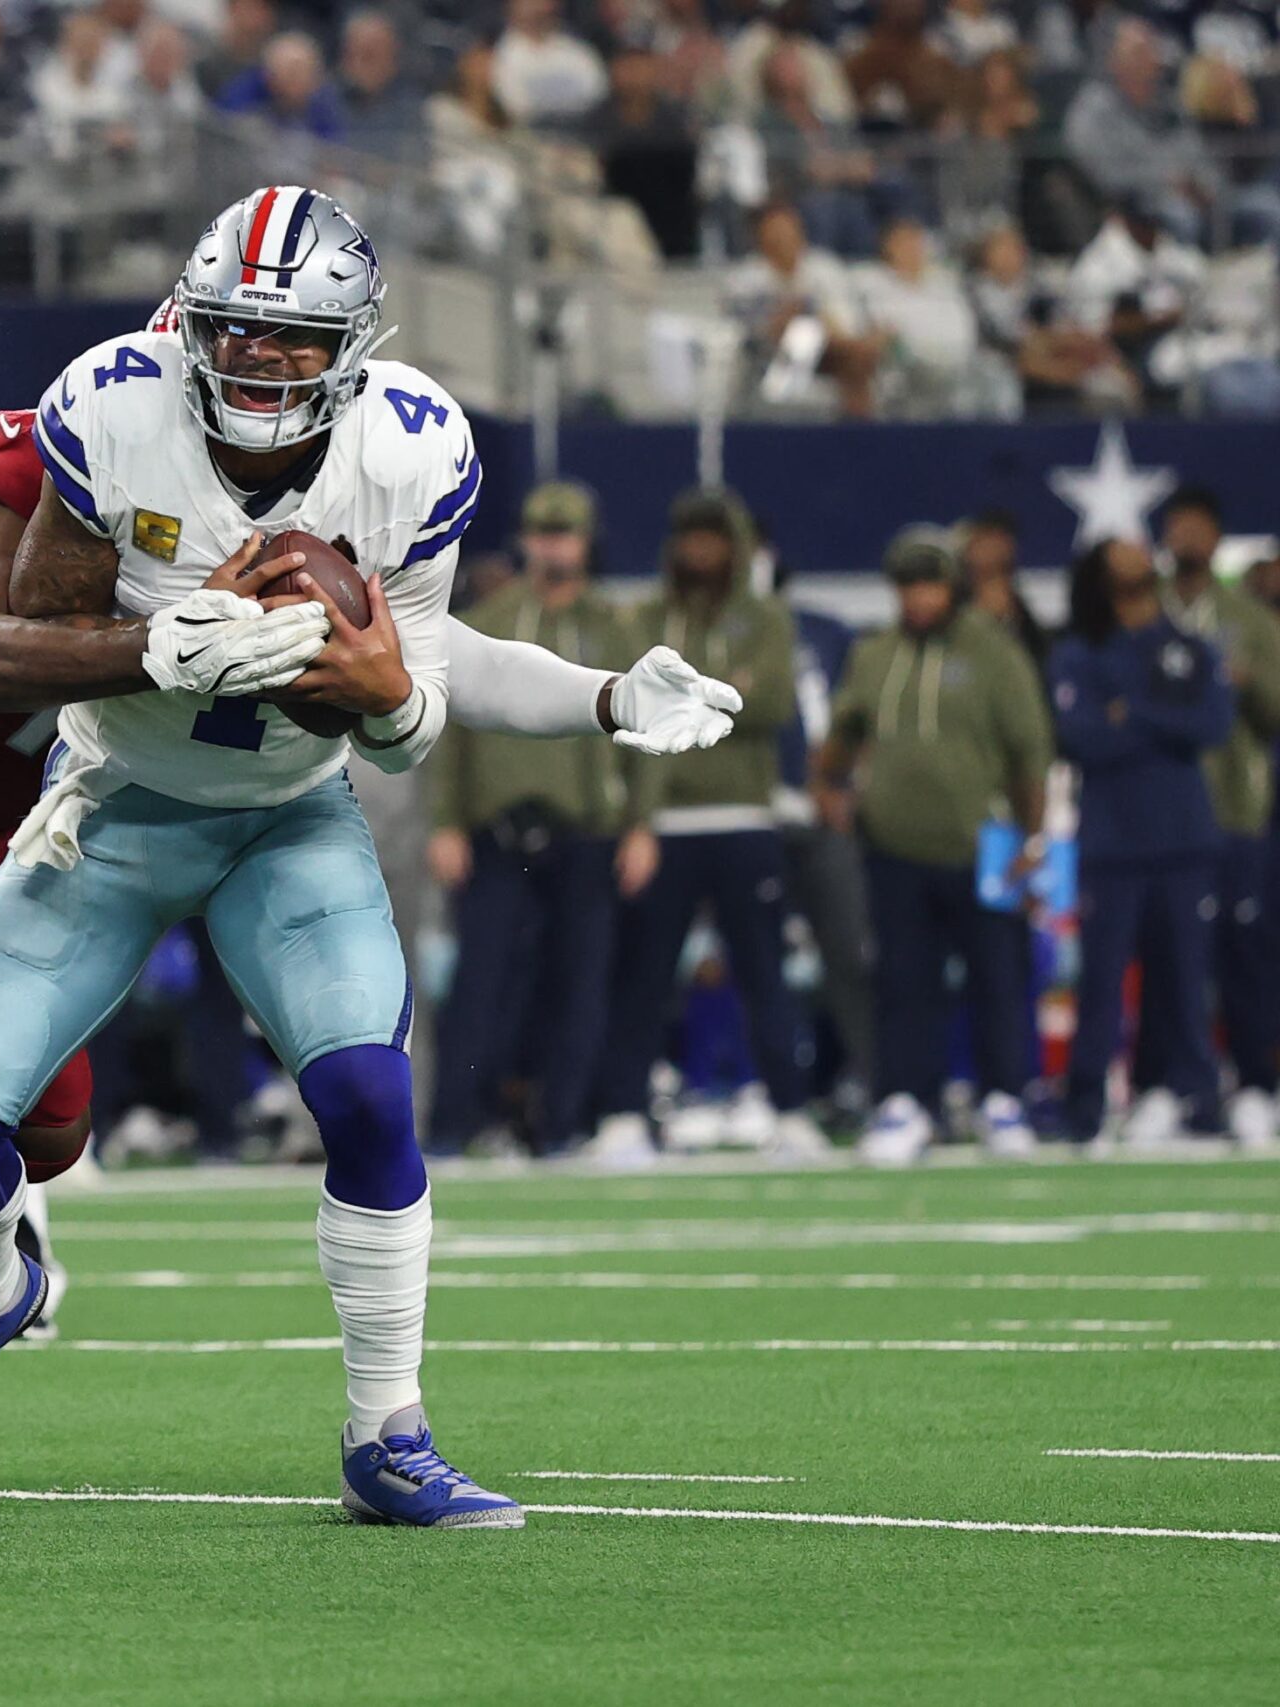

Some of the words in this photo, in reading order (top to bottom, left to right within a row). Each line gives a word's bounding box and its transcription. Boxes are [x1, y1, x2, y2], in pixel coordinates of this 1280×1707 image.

[241, 290, 288, 303] COWBOYS
[93, 346, 162, 391] 4
[383, 387, 449, 434] 4
[135, 511, 179, 552] C
